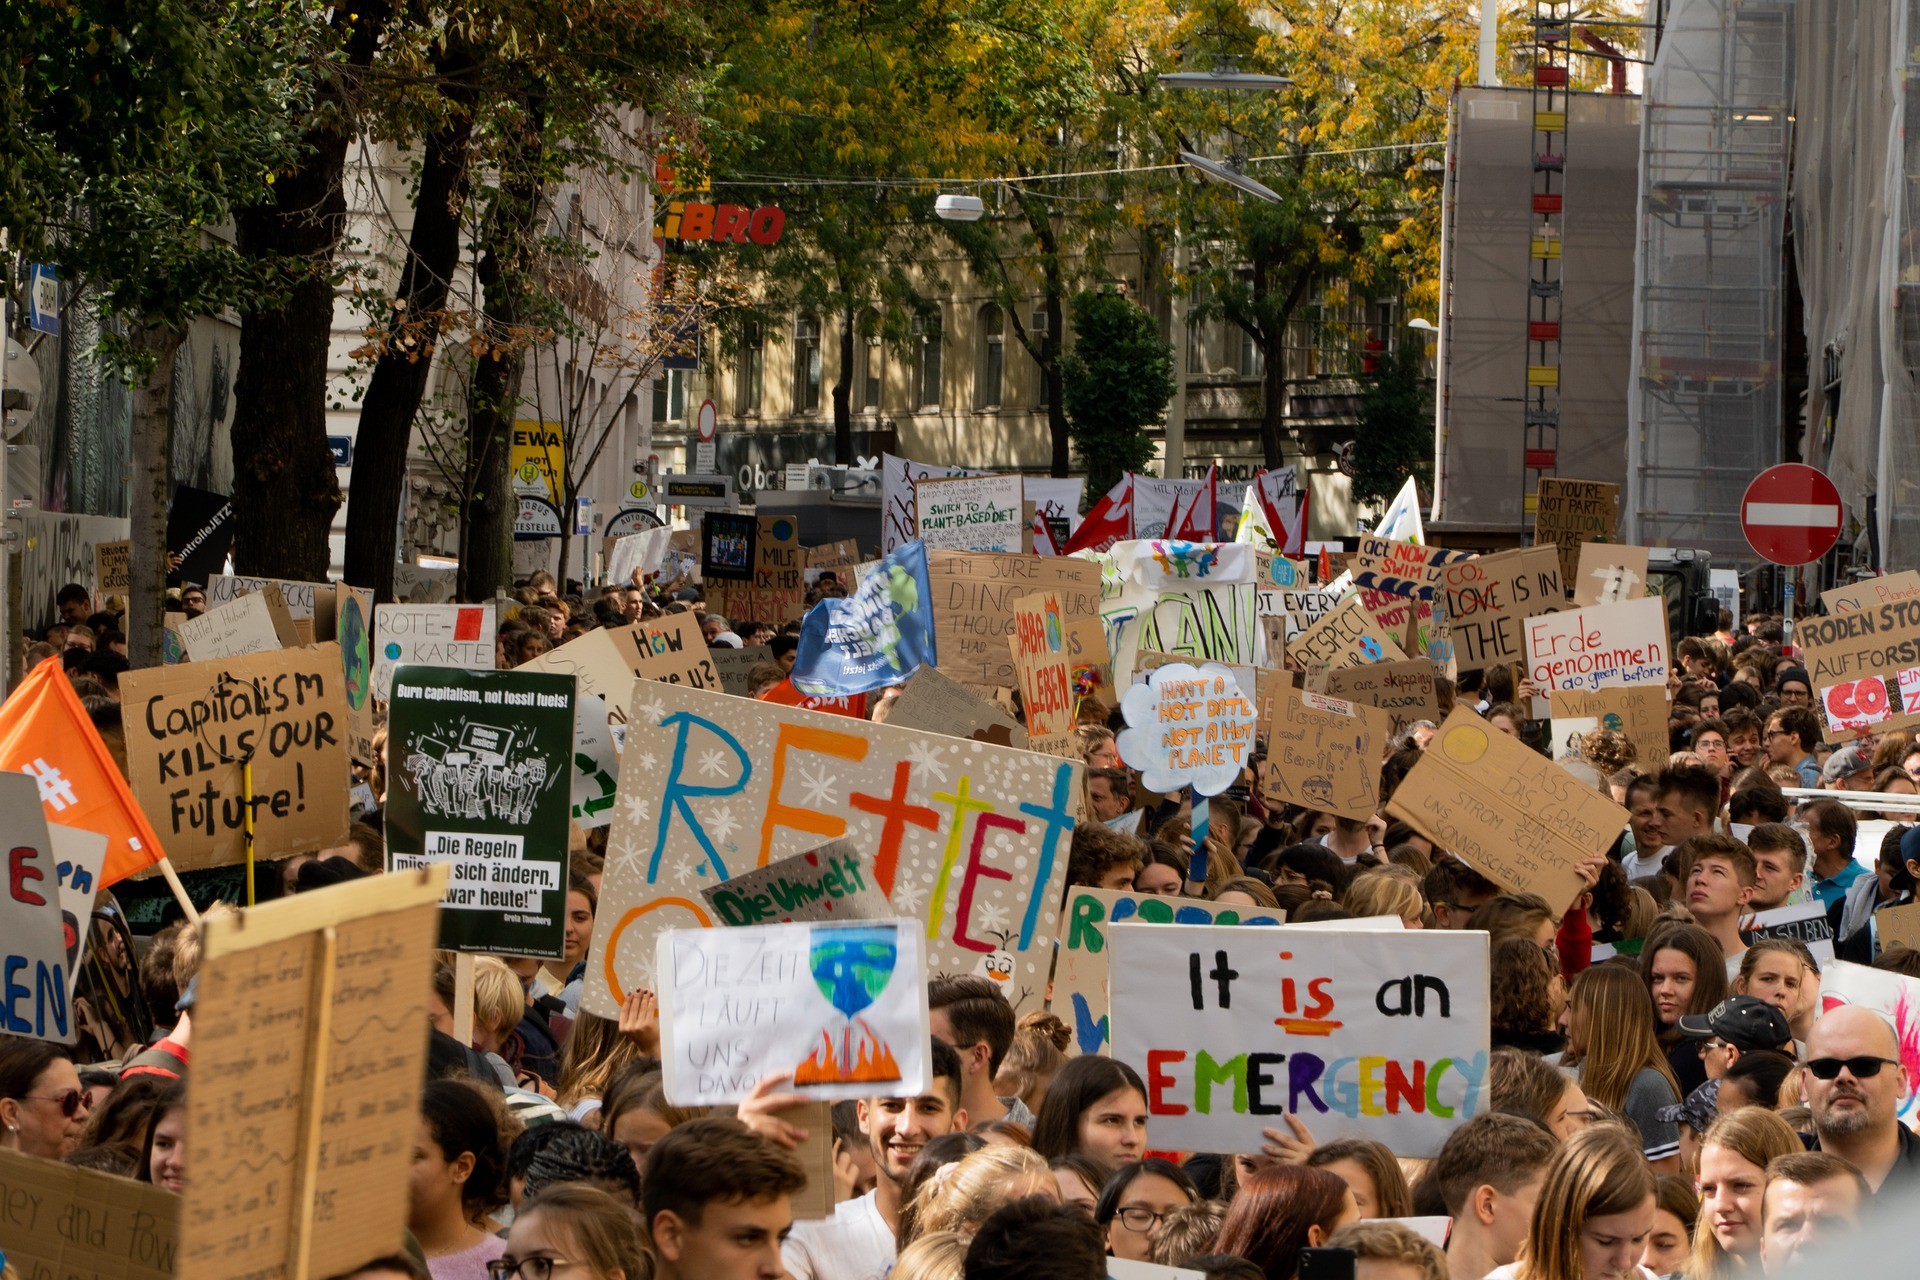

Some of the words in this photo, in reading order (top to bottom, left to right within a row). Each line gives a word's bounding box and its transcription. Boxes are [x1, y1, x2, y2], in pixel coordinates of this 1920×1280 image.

[1542, 480, 1556, 495] IF
[519, 502, 550, 517] TOBUS
[930, 502, 961, 515] SWITCH
[965, 502, 980, 512] TO
[987, 500, 996, 511] A
[1540, 496, 1565, 513] NOT
[1568, 498, 1601, 515] PART
[514, 523, 556, 532] TESTELLE
[1394, 543, 1429, 564] NOW
[989, 556, 1042, 579] SURE
[1055, 569, 1083, 582] THE
[1380, 557, 1423, 580] SWIM
[949, 581, 1098, 616] DINOURS
[1511, 574, 1530, 604] IS
[1538, 570, 1558, 598] IN
[1284, 593, 1342, 613] EVERY
[950, 613, 1017, 637] THOUG
[1531, 614, 1603, 658] Erde
[1801, 610, 1876, 649] RODEN
[1879, 599, 1920, 632] STO
[631, 627, 683, 660] HOW
[959, 638, 988, 655] HAD
[1453, 616, 1518, 662] THE
[412, 641, 492, 664] KARTE
[1533, 643, 1662, 691] genommen
[1622, 665, 1665, 683] before
[1213, 676, 1226, 696] A
[1383, 669, 1433, 695] skipping
[397, 683, 423, 699] Burn
[424, 685, 482, 705] capitalism,
[484, 690, 502, 703] not
[504, 690, 536, 707] fossil
[536, 692, 569, 709] fuels!
[1619, 694, 1646, 709] OUR
[1158, 700, 1204, 723] HOT
[1206, 697, 1253, 718] DATE
[1630, 709, 1649, 728] IS
[1162, 726, 1204, 748] NOT
[1205, 721, 1219, 744] A
[1221, 719, 1254, 741] HOT
[158, 729, 256, 785] KILLS
[269, 711, 339, 758] OUR
[1168, 741, 1247, 770] PLANET
[1516, 756, 1598, 812] LASST
[169, 761, 306, 837] Future!
[1450, 790, 1505, 831] STROM
[1499, 776, 1537, 808] DAS
[1538, 802, 1608, 851] GRABEN
[1422, 793, 1453, 820] UNS
[1513, 852, 1540, 873] DER
[464, 838, 518, 860] Regeln
[454, 861, 487, 881] sich
[491, 863, 554, 888] ändern,
[0, 954, 69, 1038] EN
[1188, 949, 1240, 1011] It
[1278, 950, 1337, 1021] is
[1375, 974, 1451, 1018] an
[688, 1039, 751, 1069] UNS
[698, 1069, 765, 1095] DAVO
[1146, 1048, 1488, 1121] EMERGENCY
[56, 1202, 110, 1249] and
[128, 1208, 181, 1274] Pow
